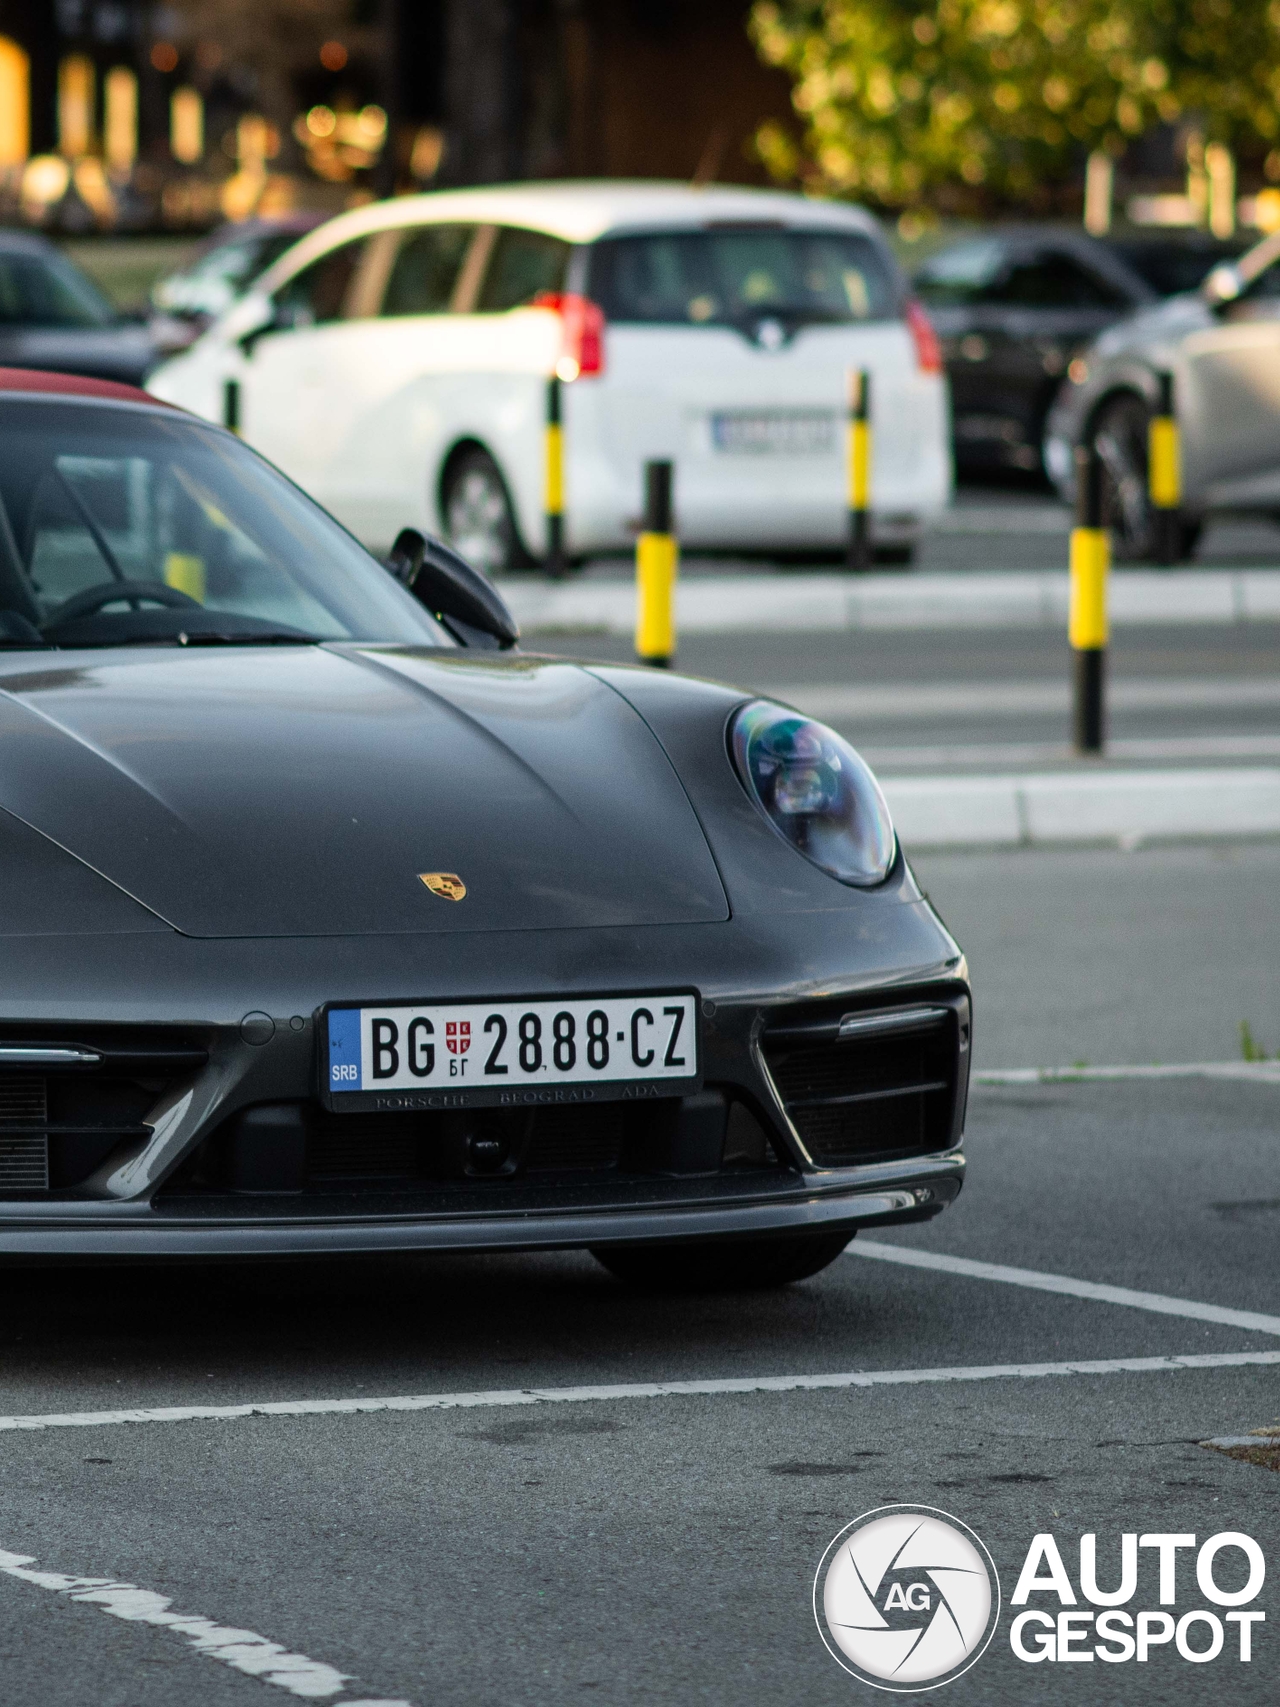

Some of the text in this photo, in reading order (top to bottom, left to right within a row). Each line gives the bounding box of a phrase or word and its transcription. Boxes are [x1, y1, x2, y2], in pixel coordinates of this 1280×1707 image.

[372, 1017, 435, 1079] BG
[332, 1064, 358, 1081] SRB
[376, 1085, 660, 1109] PORSCHE BEOGRAD ADA
